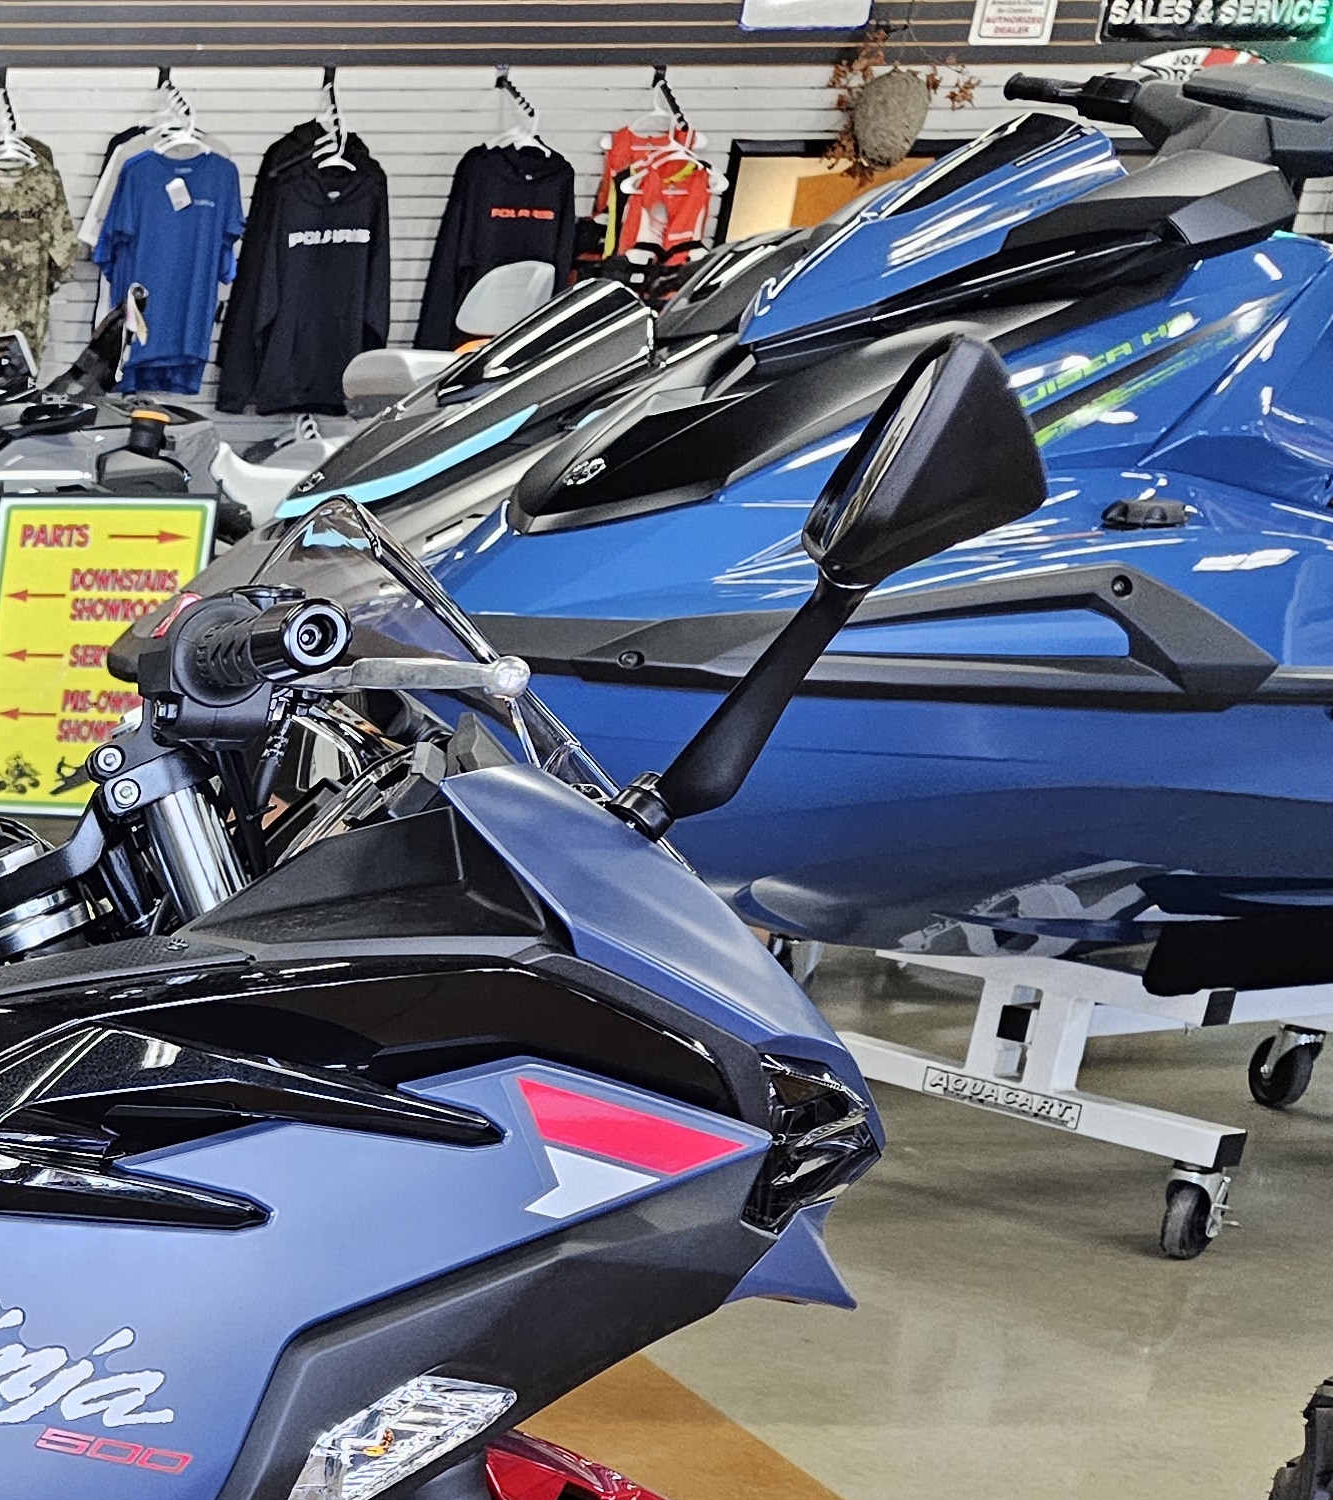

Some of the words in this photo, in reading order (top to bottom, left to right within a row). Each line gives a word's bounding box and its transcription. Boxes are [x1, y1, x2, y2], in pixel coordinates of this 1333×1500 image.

[1108, 0, 1192, 24] SALES
[1194, 0, 1214, 24] &
[1217, 0, 1329, 25] SERVICE
[1172, 54, 1200, 66] JOE
[20, 524, 90, 548] PARTS
[70, 568, 178, 593] DOWNSTAIRS
[70, 597, 161, 622] SHOWROO
[929, 1072, 1075, 1120] AQUACART
[36, 1427, 193, 1475] 500
